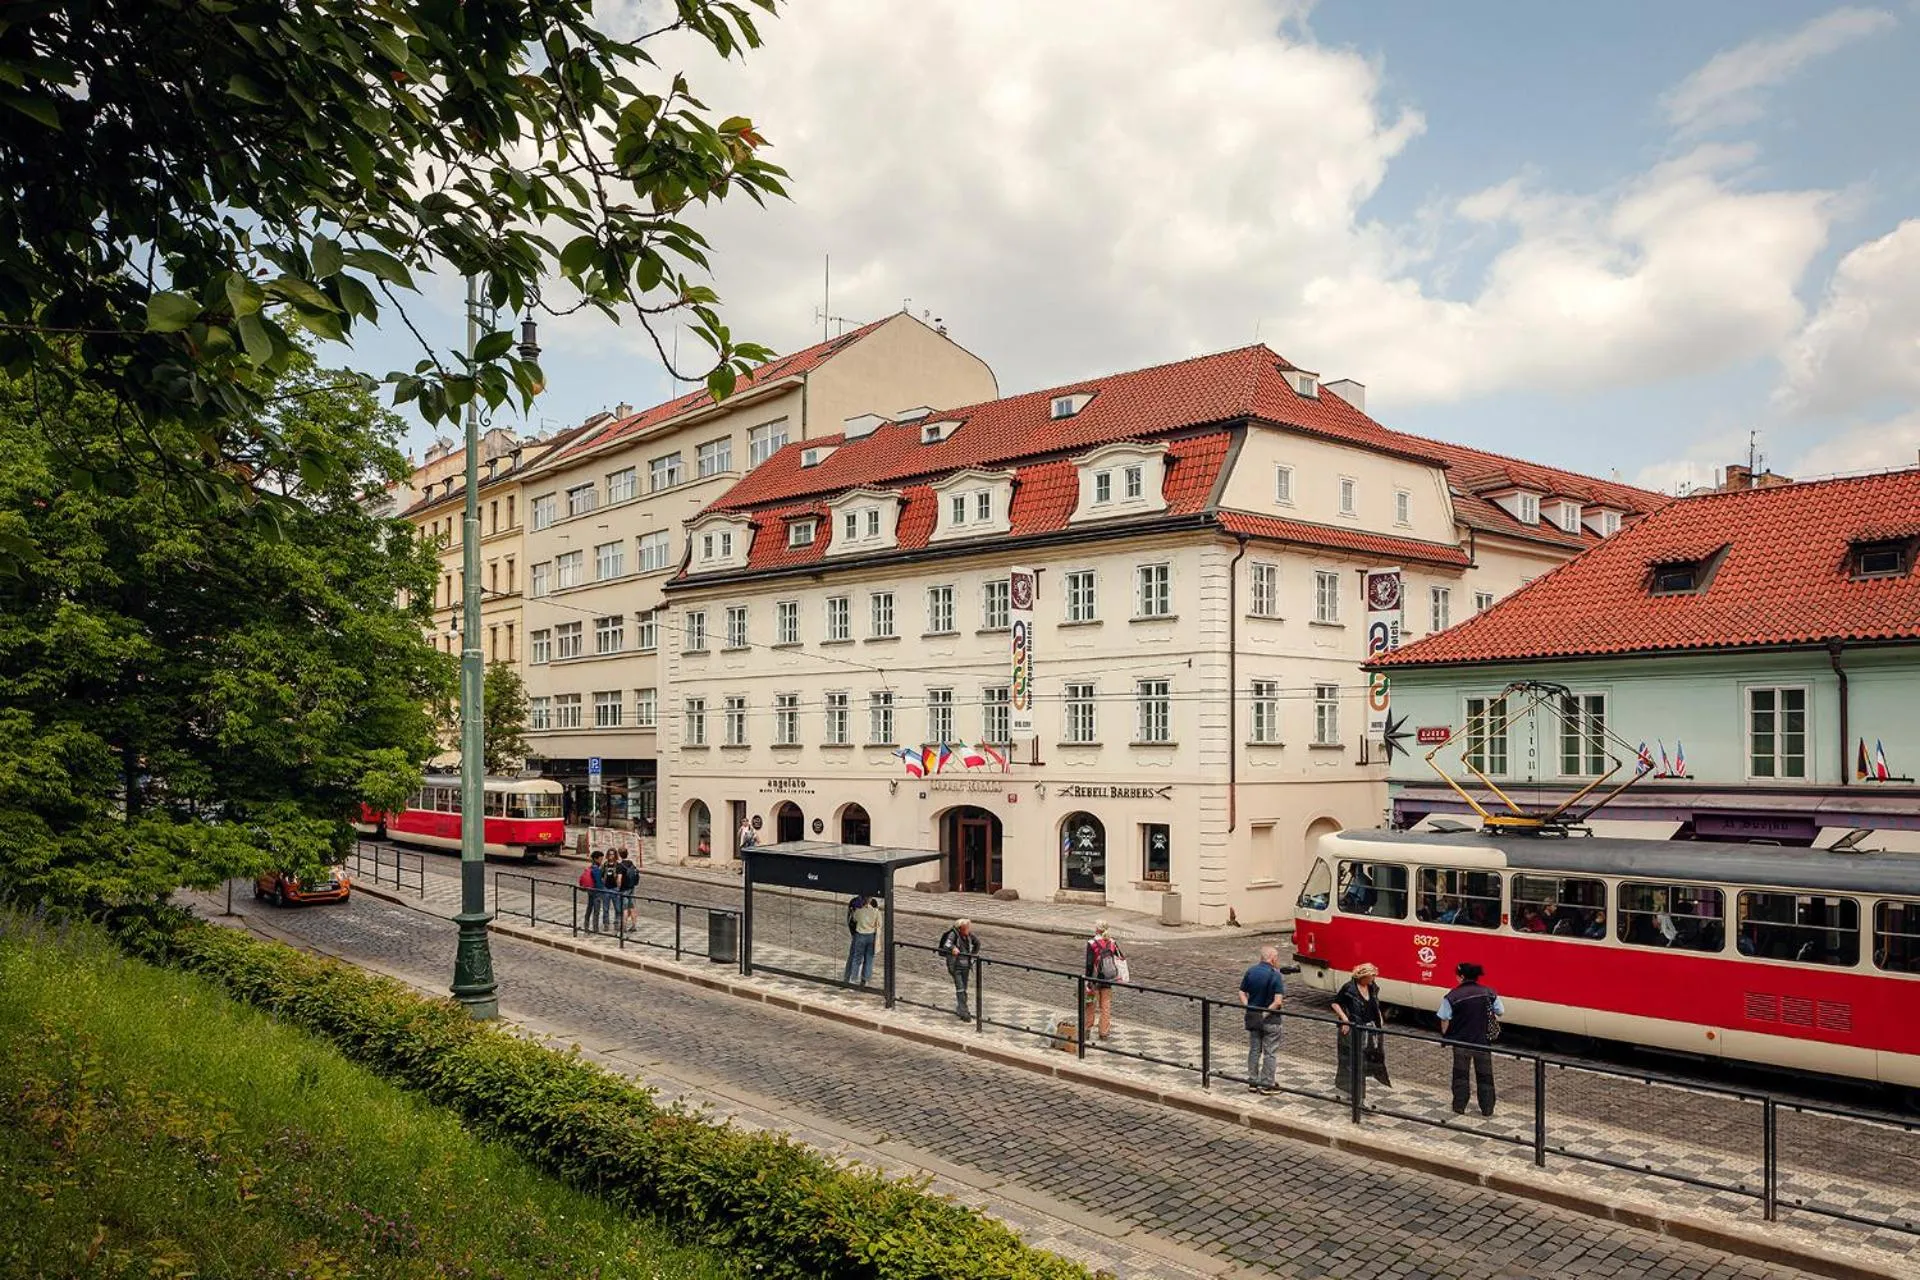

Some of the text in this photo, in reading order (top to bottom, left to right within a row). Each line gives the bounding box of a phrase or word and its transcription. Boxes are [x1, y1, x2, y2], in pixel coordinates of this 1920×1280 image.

[767, 777, 806, 789] angelato
[1074, 786, 1154, 799] REBELL BARBERS
[1414, 934, 1440, 947] 8372
